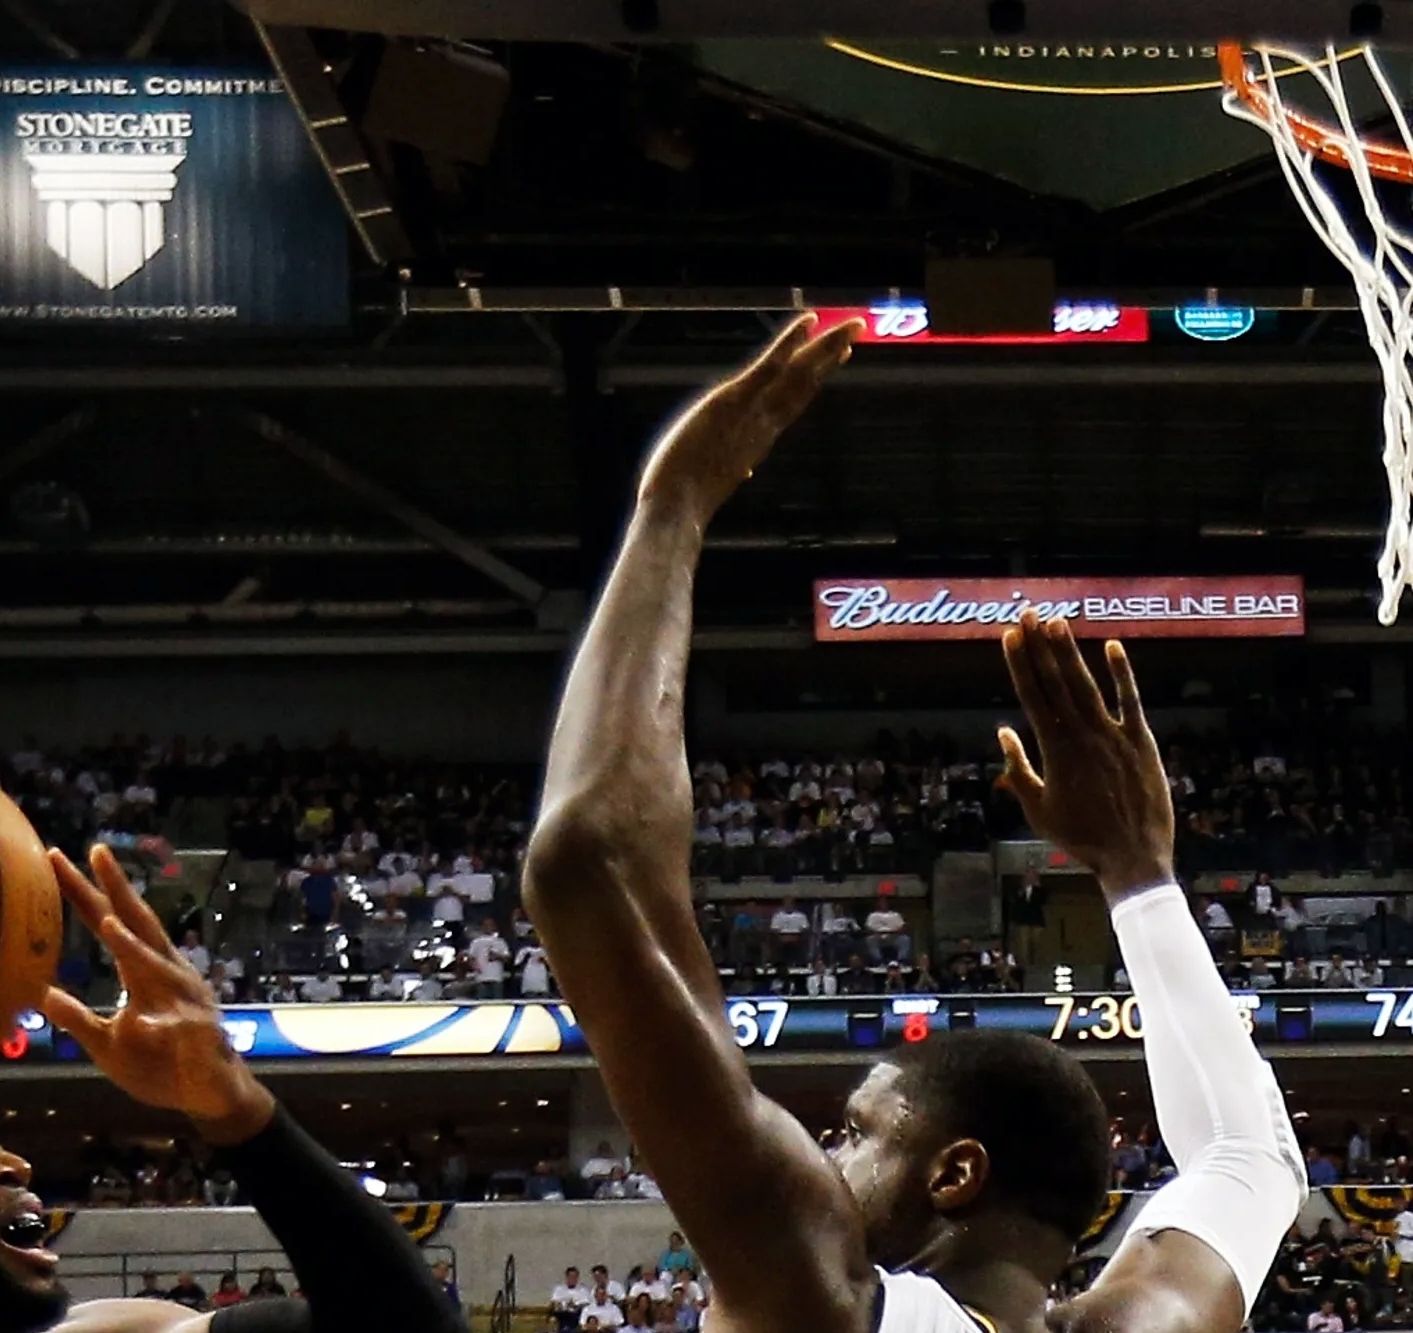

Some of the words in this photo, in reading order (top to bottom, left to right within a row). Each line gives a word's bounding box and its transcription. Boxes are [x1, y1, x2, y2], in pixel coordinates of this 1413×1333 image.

[979, 45, 1216, 58] INDIANAPOLIS
[15, 112, 193, 138] STONEGATE
[819, 585, 1081, 629] Budweiser
[1084, 595, 1226, 619] BASELINE
[1233, 594, 1298, 615] BAR
[728, 1001, 789, 1047] 67
[1044, 996, 1144, 1041] 7:30
